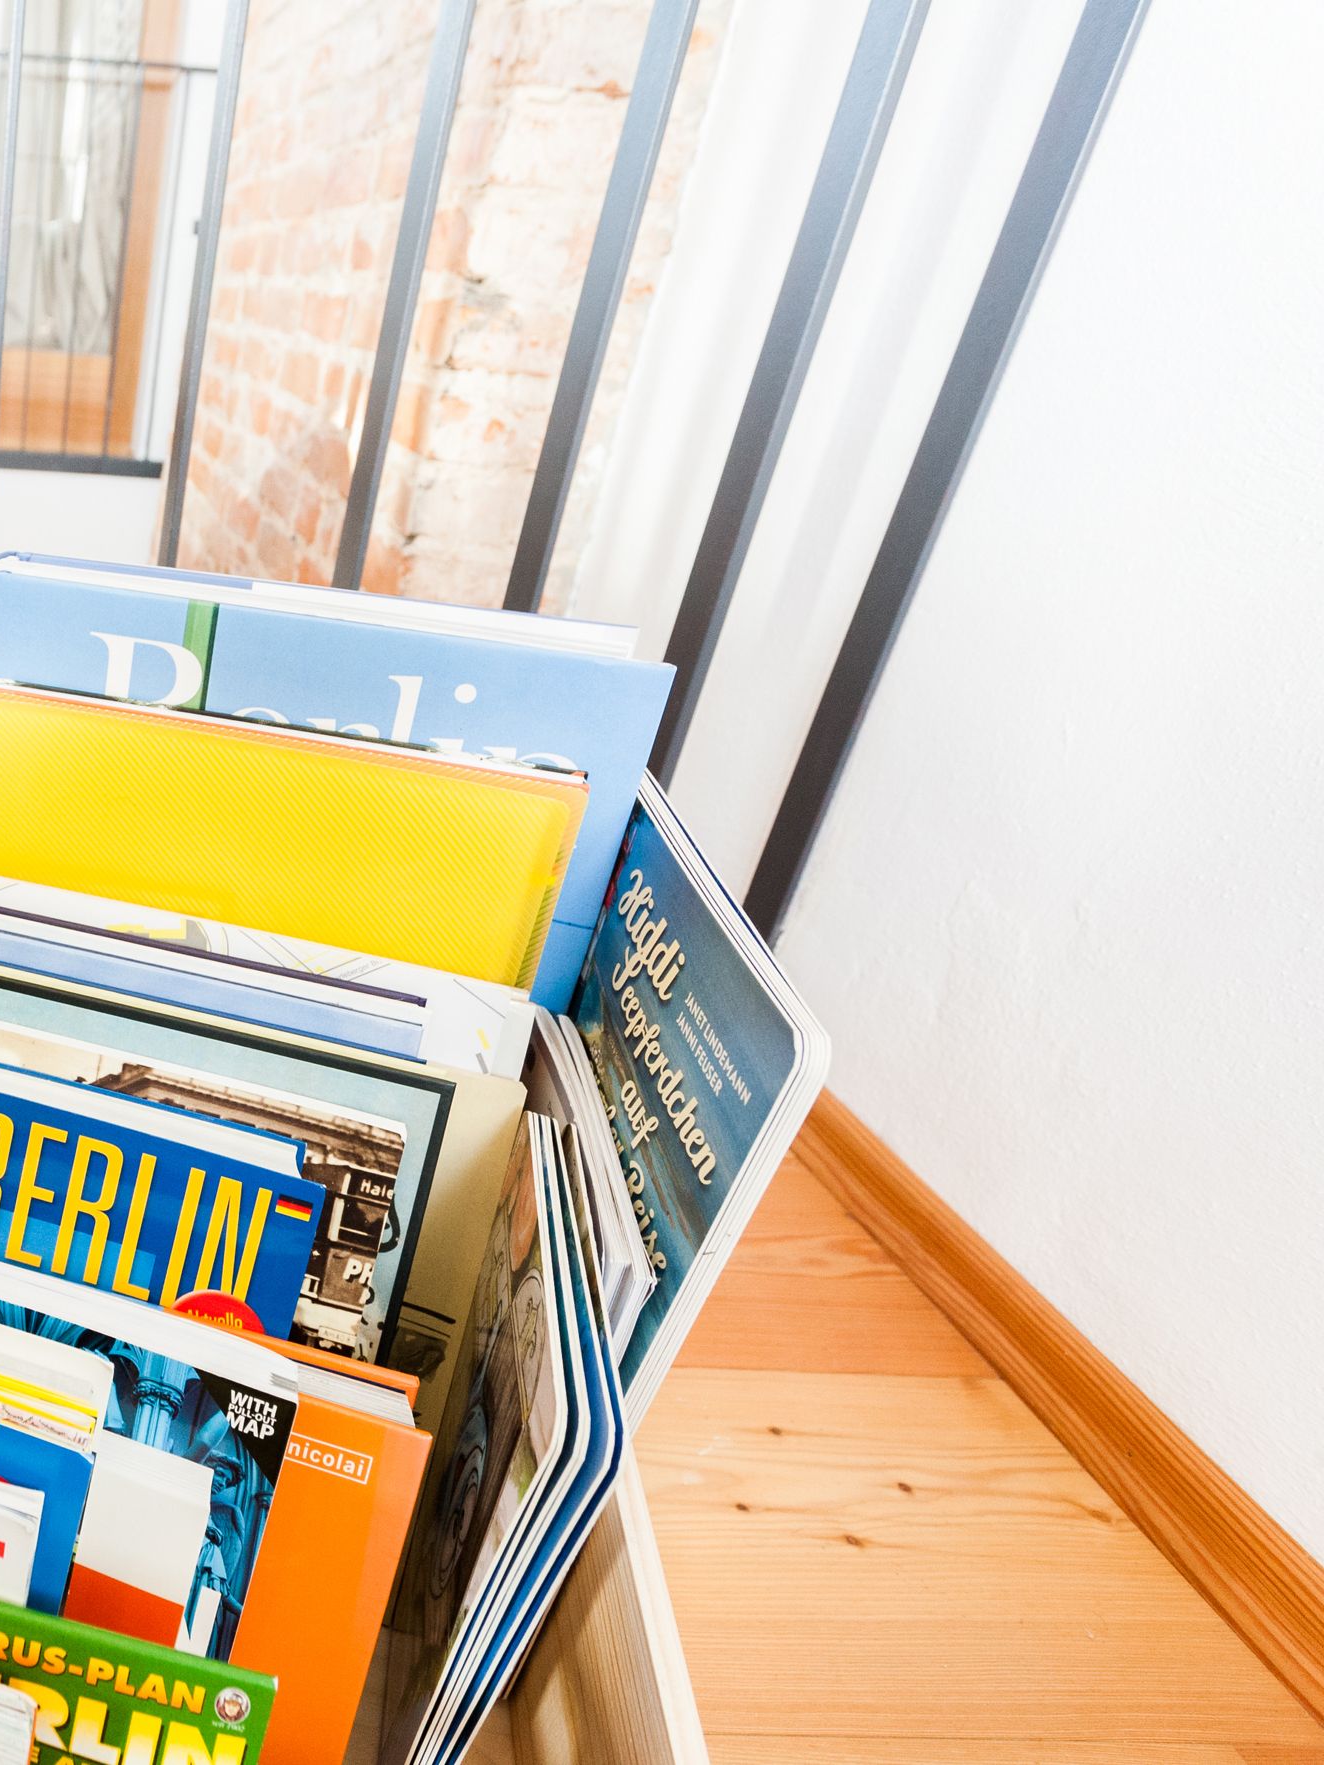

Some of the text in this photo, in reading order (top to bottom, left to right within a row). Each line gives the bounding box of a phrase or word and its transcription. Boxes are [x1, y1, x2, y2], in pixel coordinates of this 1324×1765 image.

[612, 946, 717, 1186] Seepferdchen
[676, 1011, 723, 1097] JANNI FEUSER
[684, 991, 752, 1107] JANET LINDEMANN
[621, 1079, 659, 1149] auf
[226, 1411, 275, 1440] MAP
[228, 1403, 277, 1427] PULL-OUT
[230, 1389, 278, 1418] WITH
[287, 1440, 365, 1478] nicolai
